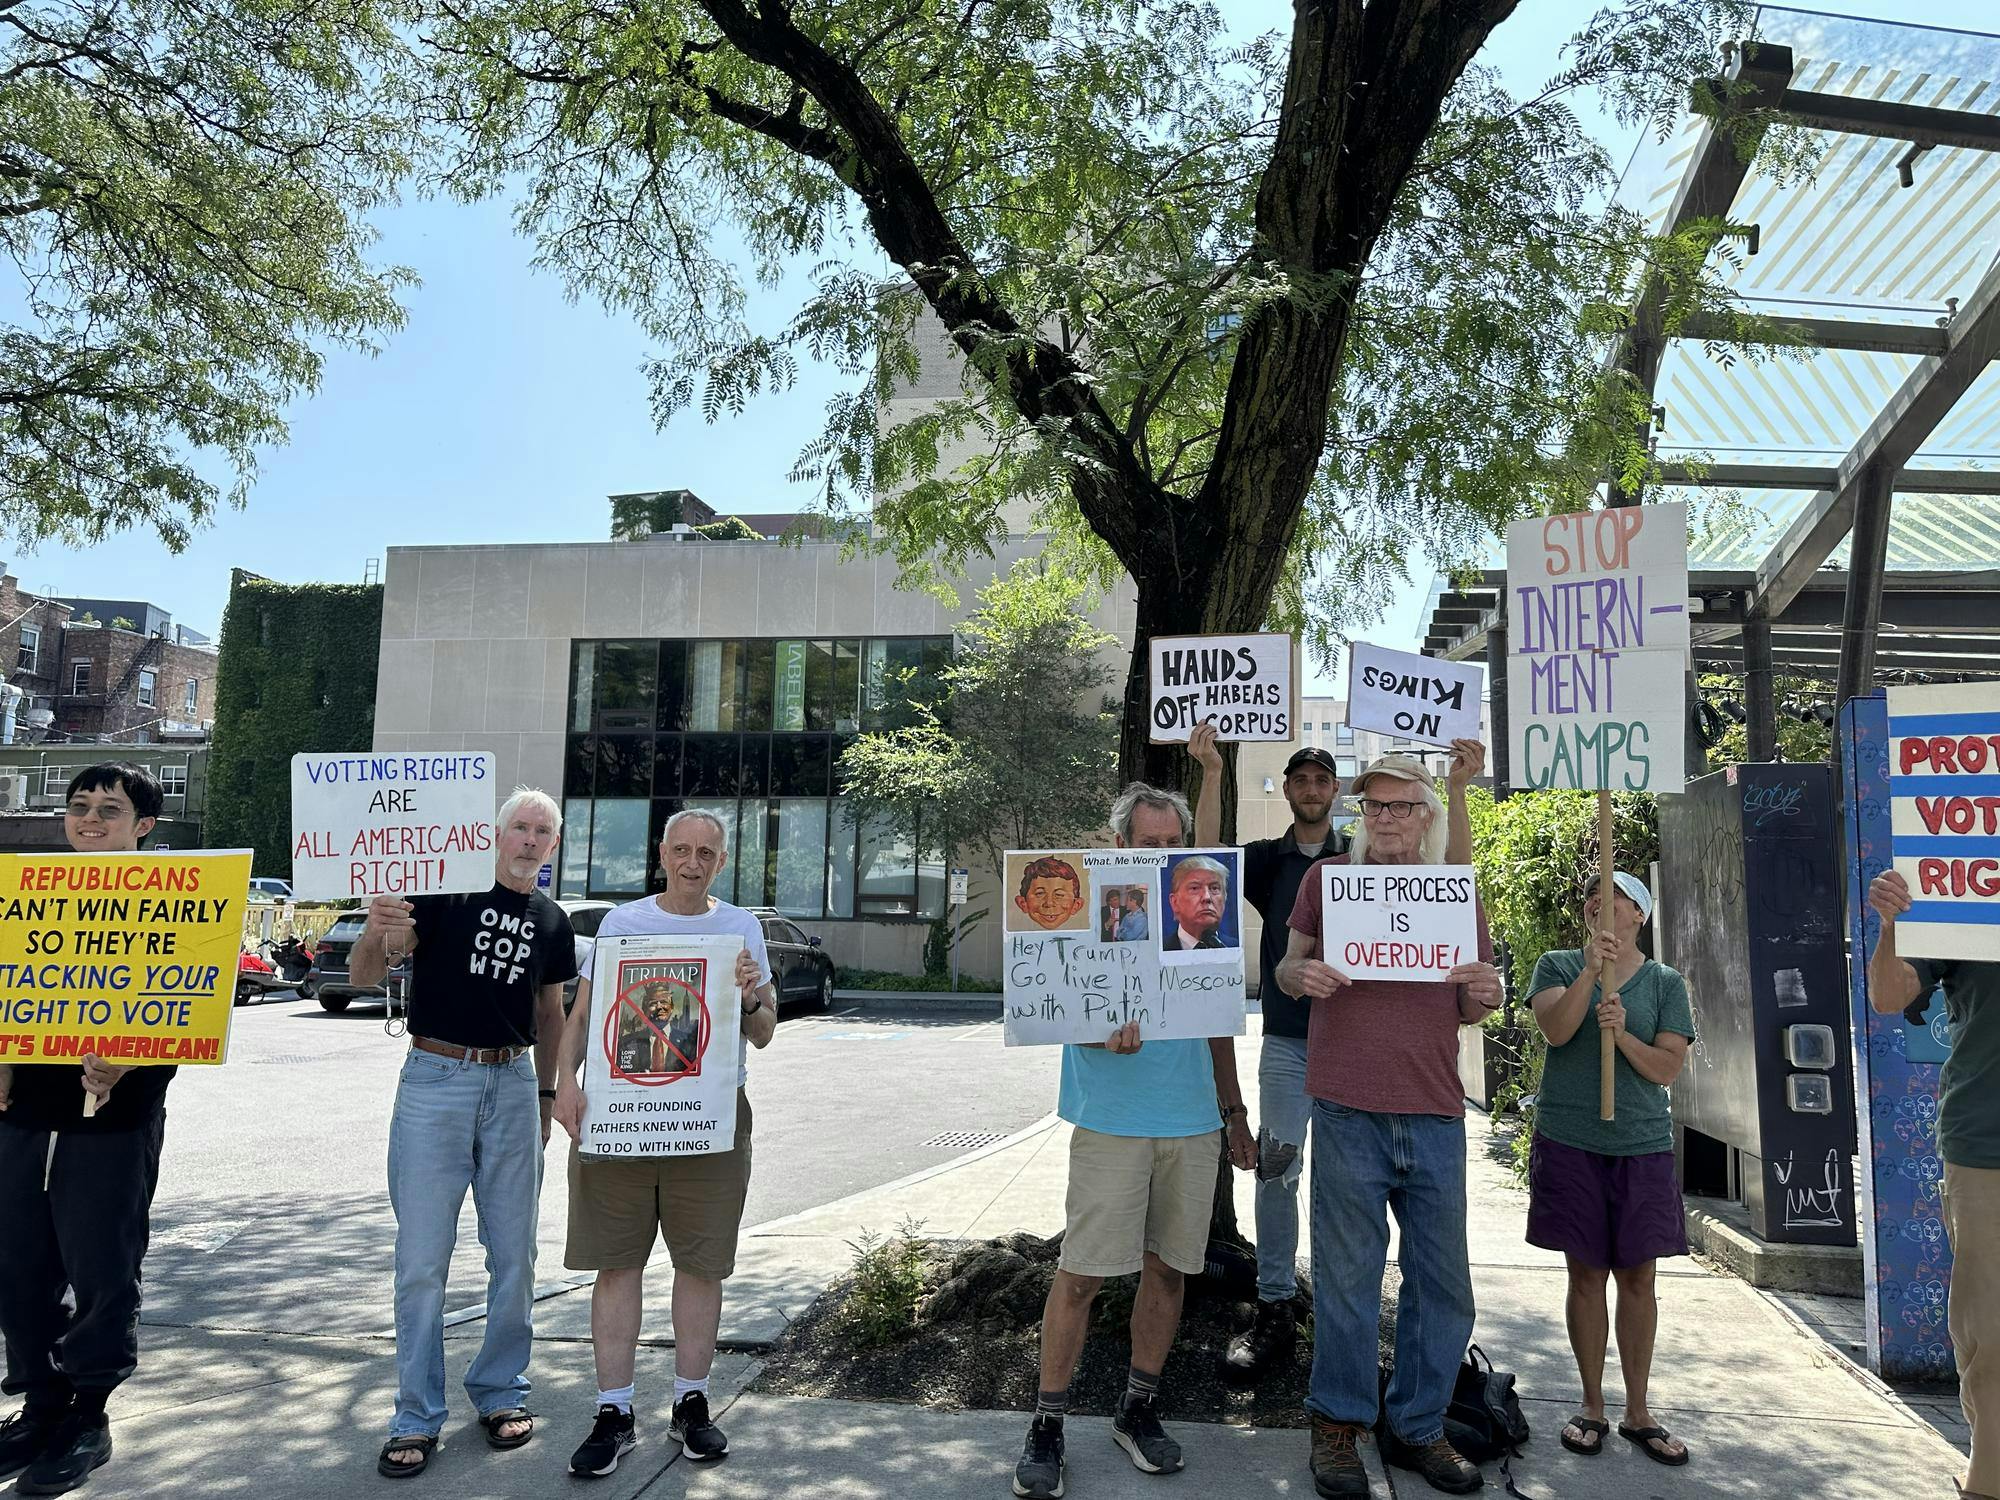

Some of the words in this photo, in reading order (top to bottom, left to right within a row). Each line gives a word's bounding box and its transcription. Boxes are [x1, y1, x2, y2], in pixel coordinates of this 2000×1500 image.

[1543, 507, 1644, 576] STOP
[1516, 576, 1683, 653] INTERN-
[1162, 647, 1257, 686] HANDS
[1205, 684, 1280, 706] HABEAS
[1362, 666, 1465, 711] KINGS
[1531, 652, 1619, 715] MENT
[1394, 711, 1442, 738] NO
[306, 758, 398, 784] VOTING
[404, 756, 486, 781] RIGHTS
[1525, 721, 1649, 792] CAMPS
[368, 788, 417, 814] ARE
[294, 831, 340, 859] ALL
[350, 822, 491, 857] AMERICAN'S
[1115, 856, 1130, 865] Me
[1132, 855, 1167, 865] Worry?
[19, 866, 201, 892] REPUBLICANS
[350, 859, 445, 895] RIGHT!
[1331, 877, 1375, 902] DUE
[1385, 877, 1470, 903] PROCESS
[77, 898, 134, 923] WIN
[137, 898, 229, 923] FAIRLY
[480, 908, 535, 940] OMG
[1391, 913, 1410, 932] IS
[25, 930, 64, 954] SO
[74, 931, 176, 955] THEY'RE
[474, 931, 531, 962] GOP
[1012, 936, 1044, 965] Hey
[1049, 937, 1137, 965] Trump,
[1345, 942, 1460, 969] OVERDUE!
[145, 964, 219, 991] YOUR
[470, 953, 525, 984] WTF
[626, 966, 699, 984] TRUMP
[1011, 962, 1047, 988] Go
[1063, 963, 1112, 990] live
[1159, 965, 1243, 993] Moscow
[77, 1000, 111, 1025] TO
[122, 1000, 191, 1026] VOTE
[1012, 994, 1065, 1021] with
[42, 1035, 220, 1059] UNAMERICAN!
[608, 1102, 635, 1114] OUR
[637, 1100, 702, 1113] FOUNDING
[590, 1121, 640, 1134] FATHERS
[642, 1120, 679, 1132] KNEW
[682, 1120, 718, 1131] WHAT
[595, 1143, 612, 1154] TO
[614, 1142, 632, 1153] DO
[638, 1141, 671, 1152] WITH
[674, 1140, 710, 1152] KINGS
